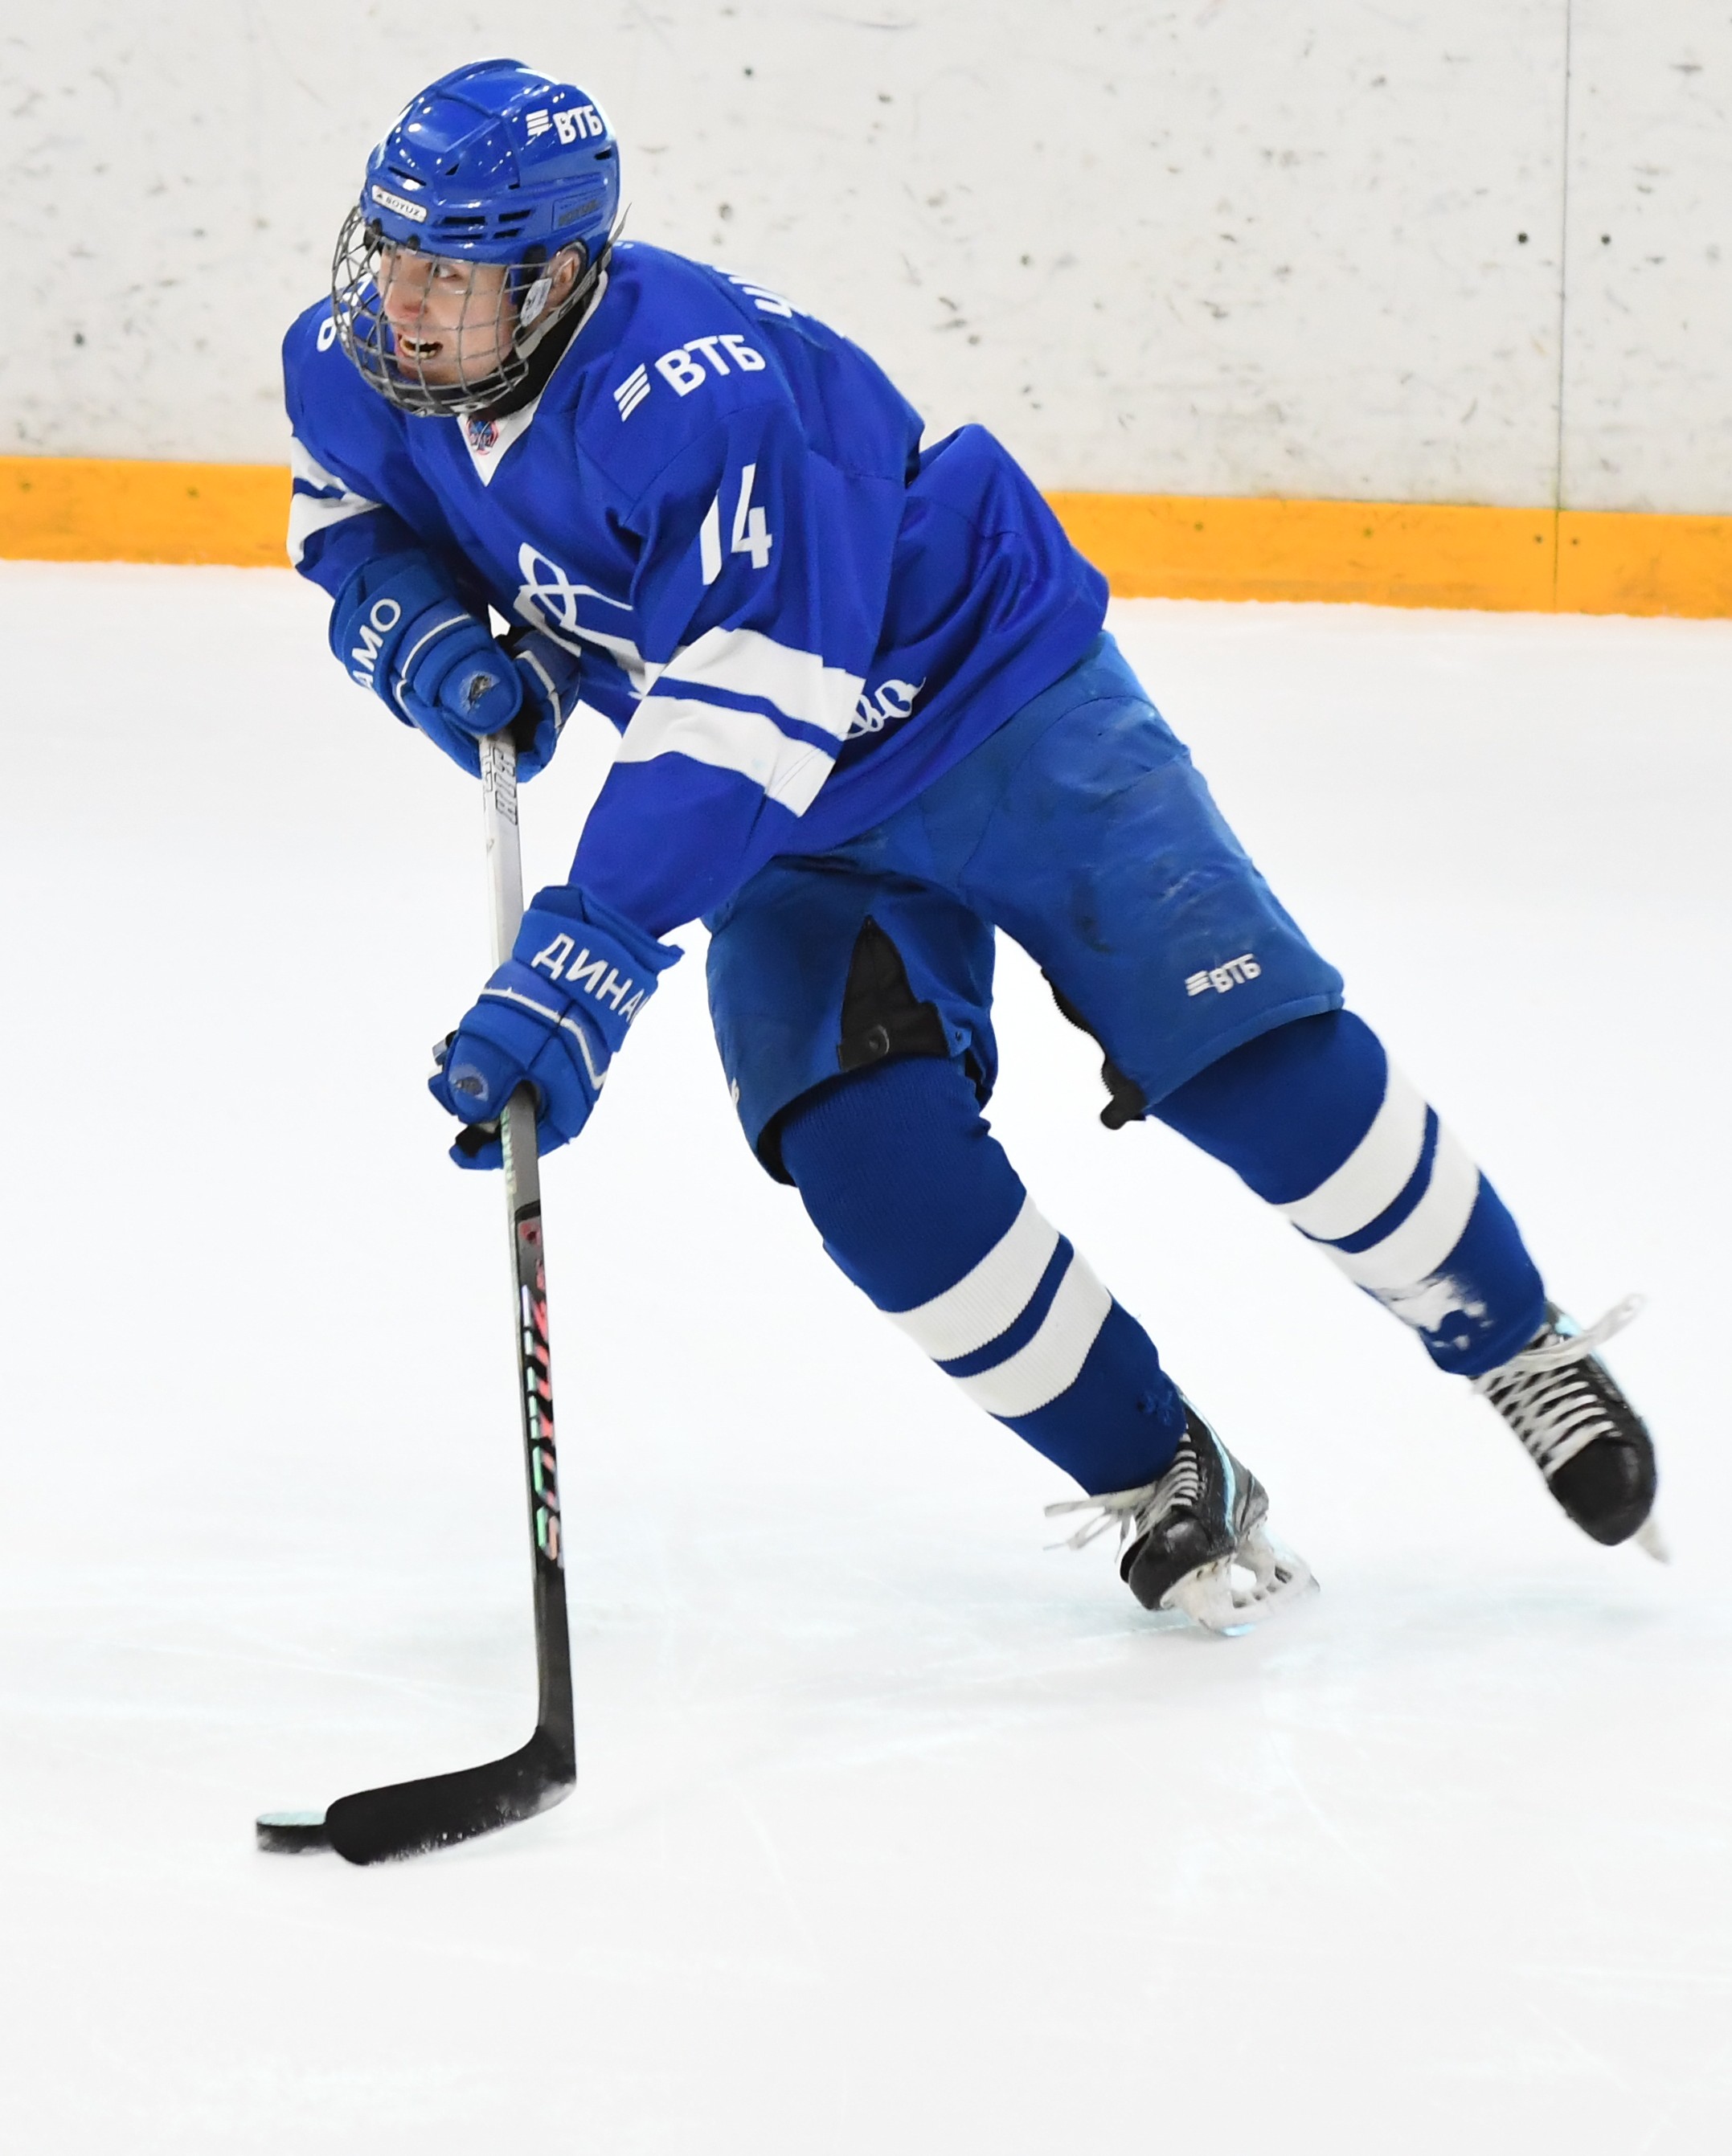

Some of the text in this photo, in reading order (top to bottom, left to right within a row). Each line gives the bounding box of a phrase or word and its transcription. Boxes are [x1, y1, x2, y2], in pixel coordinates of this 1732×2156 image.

[552, 104, 603, 145] ВТБ
[386, 197, 420, 215] SOYUZ
[654, 334, 766, 397] ВТБ
[700, 463, 772, 586] 14
[530, 932, 650, 1025] ДИНА
[1209, 953, 1262, 993] ВТБ
